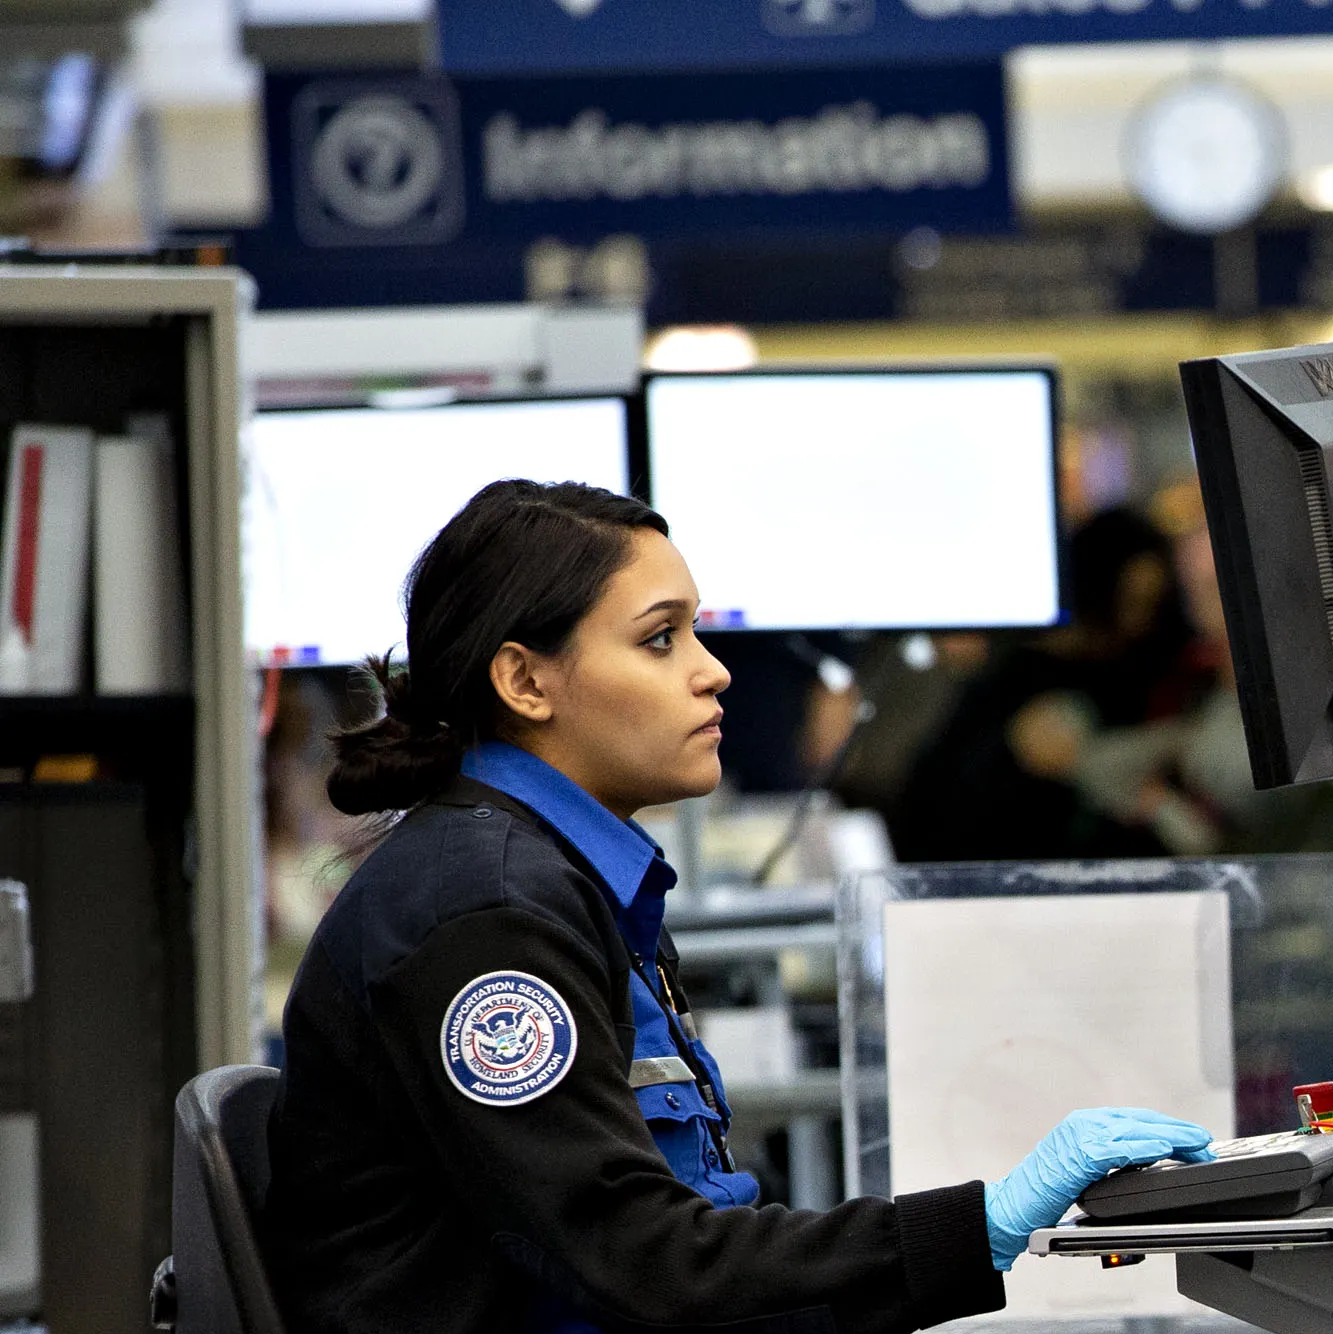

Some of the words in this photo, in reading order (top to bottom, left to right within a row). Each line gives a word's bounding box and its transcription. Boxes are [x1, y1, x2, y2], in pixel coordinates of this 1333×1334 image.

[484, 102, 987, 198] Information
[449, 981, 514, 1063] TRANSPORTATION
[517, 983, 565, 1025] SECURITY
[472, 998, 534, 1023] DEPARTMENT
[469, 1057, 519, 1079] HOMELAND
[522, 1032, 550, 1074] SECURITY
[471, 1053, 564, 1096] ADMINISTRATION
